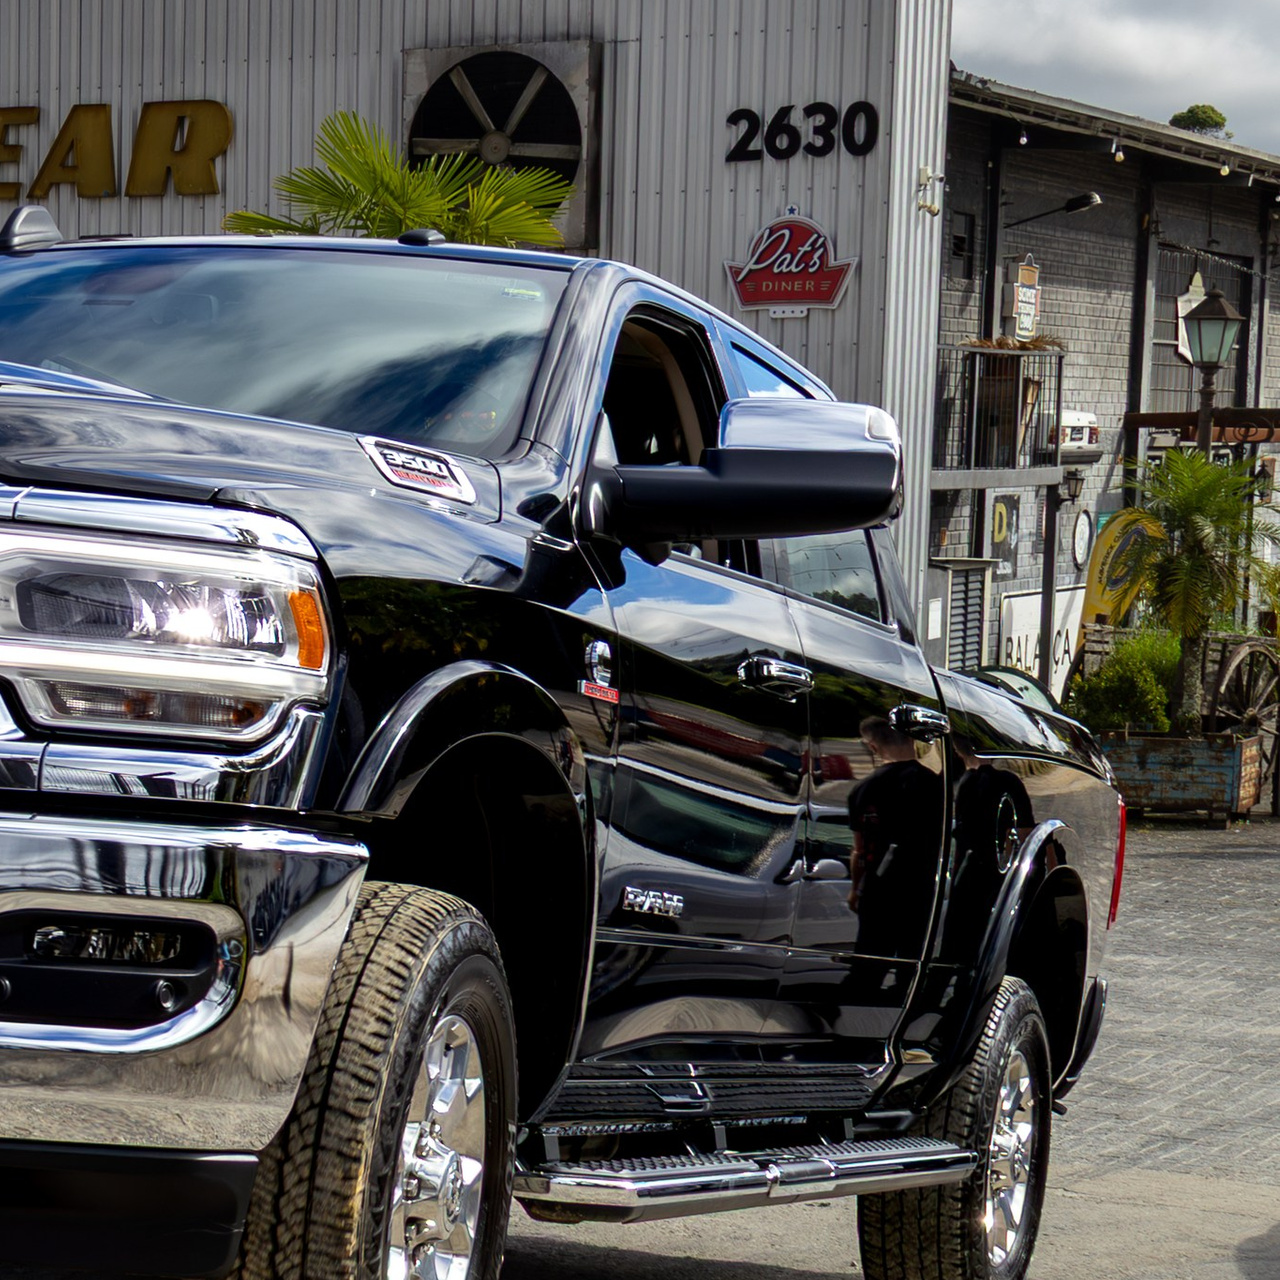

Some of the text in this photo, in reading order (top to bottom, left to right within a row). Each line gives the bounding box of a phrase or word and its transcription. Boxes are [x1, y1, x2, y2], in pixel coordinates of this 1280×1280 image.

[724, 100, 880, 162] 2630
[736, 228, 827, 282] Pat's
[762, 280, 816, 293] DINER
[1005, 628, 1073, 675] BALAÇA
